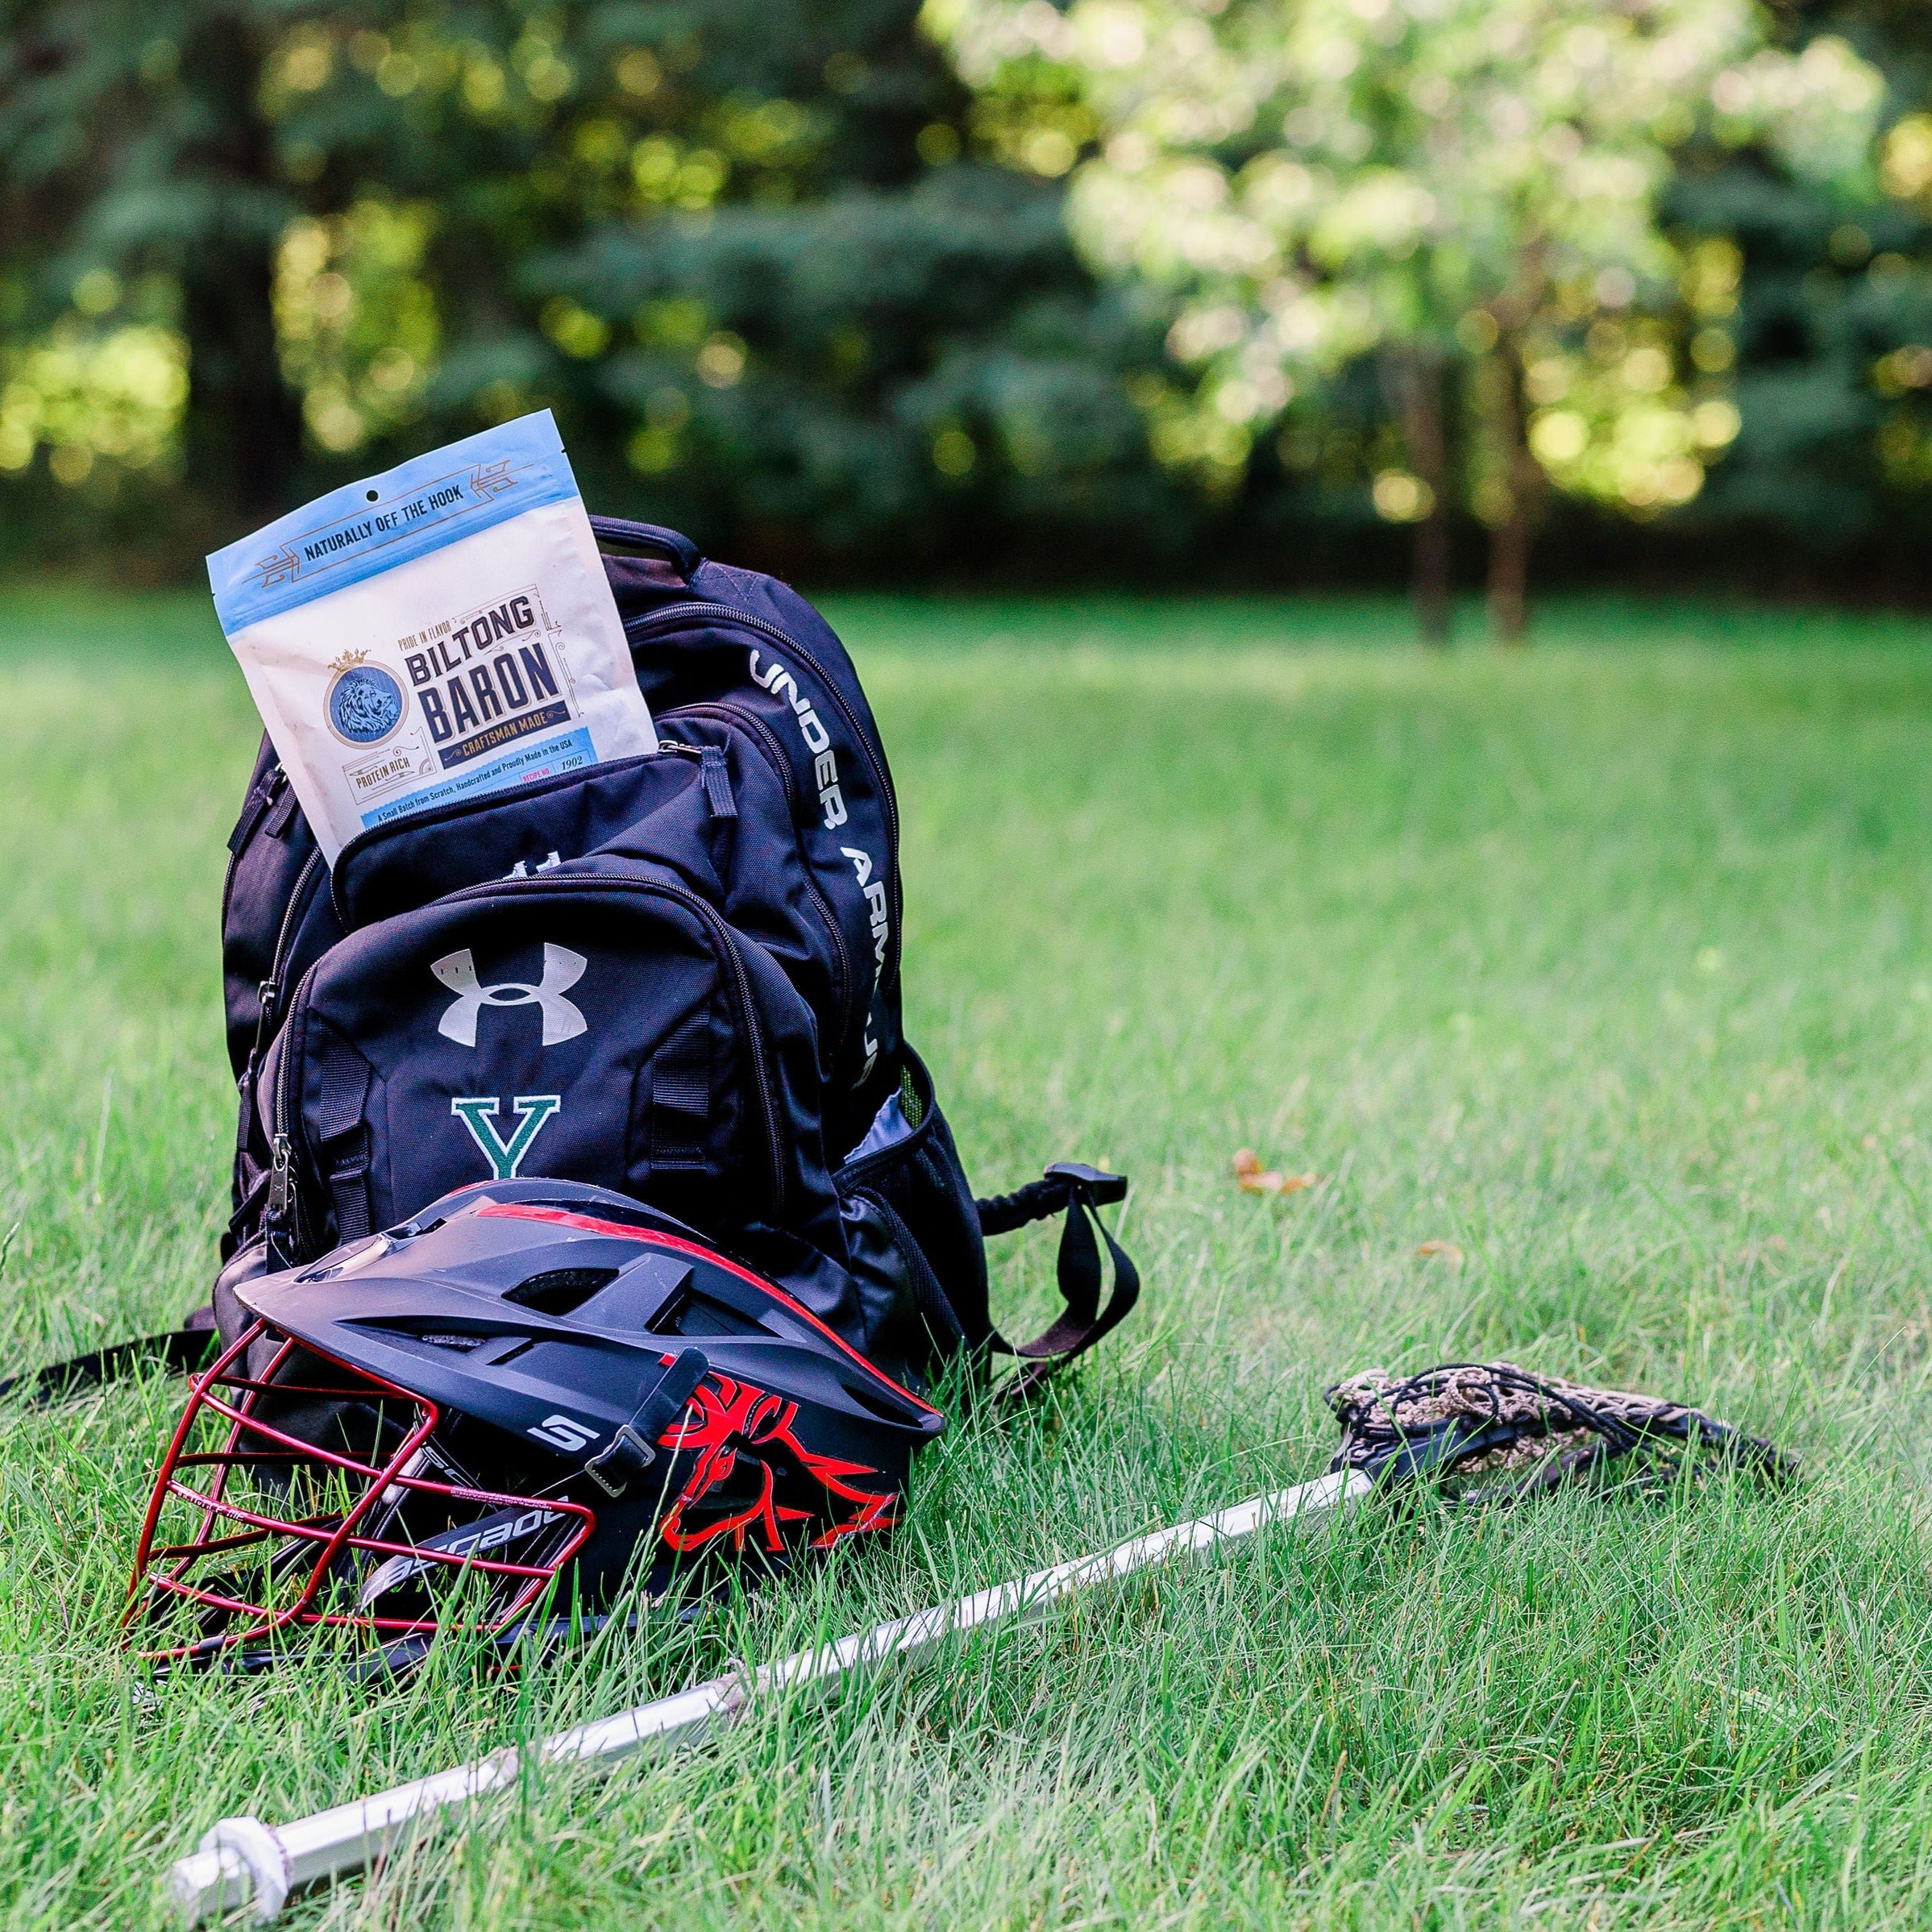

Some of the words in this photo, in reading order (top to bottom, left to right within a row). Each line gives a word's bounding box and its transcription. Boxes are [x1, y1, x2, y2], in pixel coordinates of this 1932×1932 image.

[304, 521, 372, 561] NATURALLY
[375, 511, 398, 532] OFF
[401, 500, 427, 521] THE
[428, 484, 463, 510] HOOK
[398, 634, 418, 651] PRIDE
[419, 630, 428, 644] IN
[428, 620, 452, 640] FLAVOR
[405, 596, 534, 687] BILTONG
[418, 642, 562, 746] BARON
[462, 722, 517, 756] CRAFTSMAN
[517, 712, 548, 737] MADE
[561, 755, 584, 771] 1902
[750, 649, 848, 829] UNDER
[355, 765, 389, 789] PROTEIN
[388, 757, 410, 773] RICH
[377, 814, 383, 822] A
[383, 808, 399, 820] Small
[399, 801, 415, 813] Batch
[415, 796, 430, 807] from
[430, 786, 455, 800] Scratch,
[455, 767, 492, 791] Handcrafted
[491, 767, 502, 775] and
[502, 758, 524, 772] Proudly
[525, 751, 542, 762] Made
[542, 747, 548, 756] in
[548, 744, 559, 754] the
[559, 739, 573, 750] USA
[522, 771, 540, 783] RECIPE
[451, 1095, 561, 1179] Y
